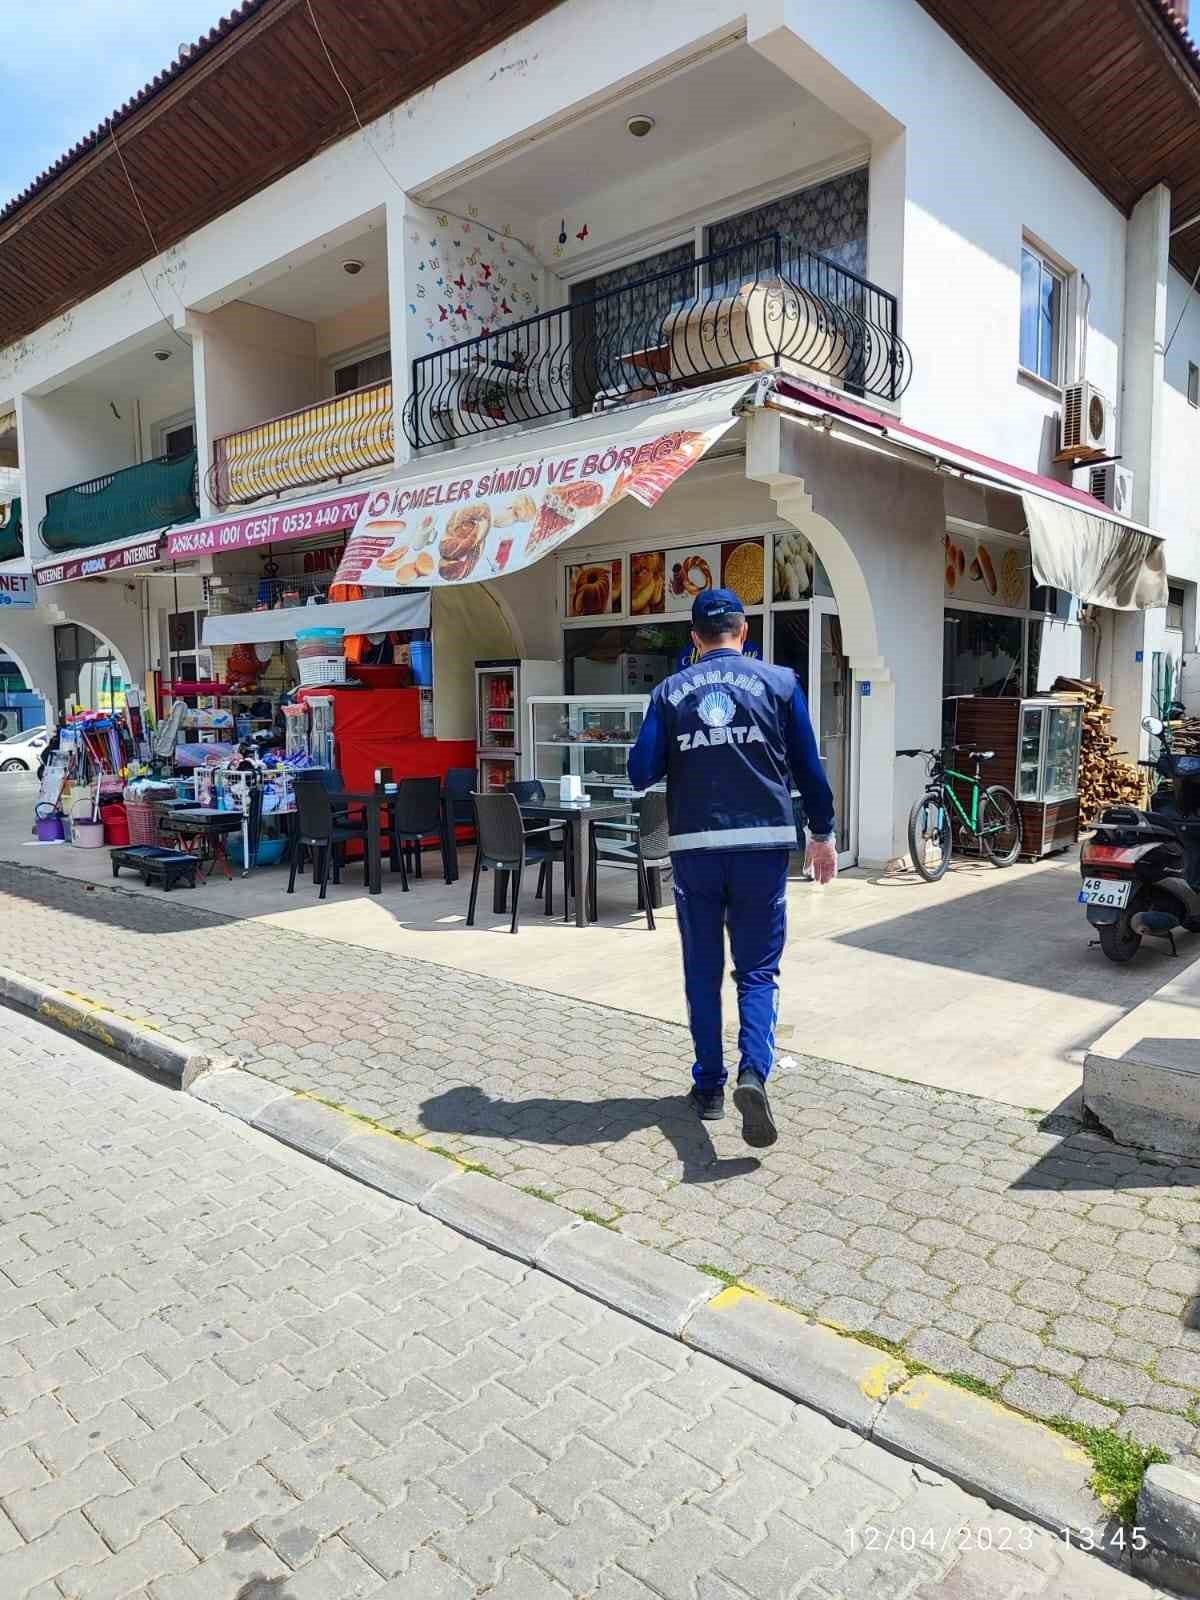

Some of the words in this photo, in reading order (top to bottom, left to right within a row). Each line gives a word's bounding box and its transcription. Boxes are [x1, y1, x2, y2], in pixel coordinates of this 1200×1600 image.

[391, 479, 474, 517] İÇMELER
[476, 457, 544, 498] SİMİDİ
[548, 458, 578, 485] VE
[171, 533, 214, 554] ANKARA
[245, 515, 280, 545] ÇEŞİT
[282, 512, 312, 533] 0532
[315, 507, 338, 527] 440
[123, 543, 157, 565] INTERNET
[668, 670, 766, 707] MARMARİS
[1085, 879, 1101, 890] 48
[1118, 884, 1126, 893] J
[1090, 892, 1122, 905] 7601
